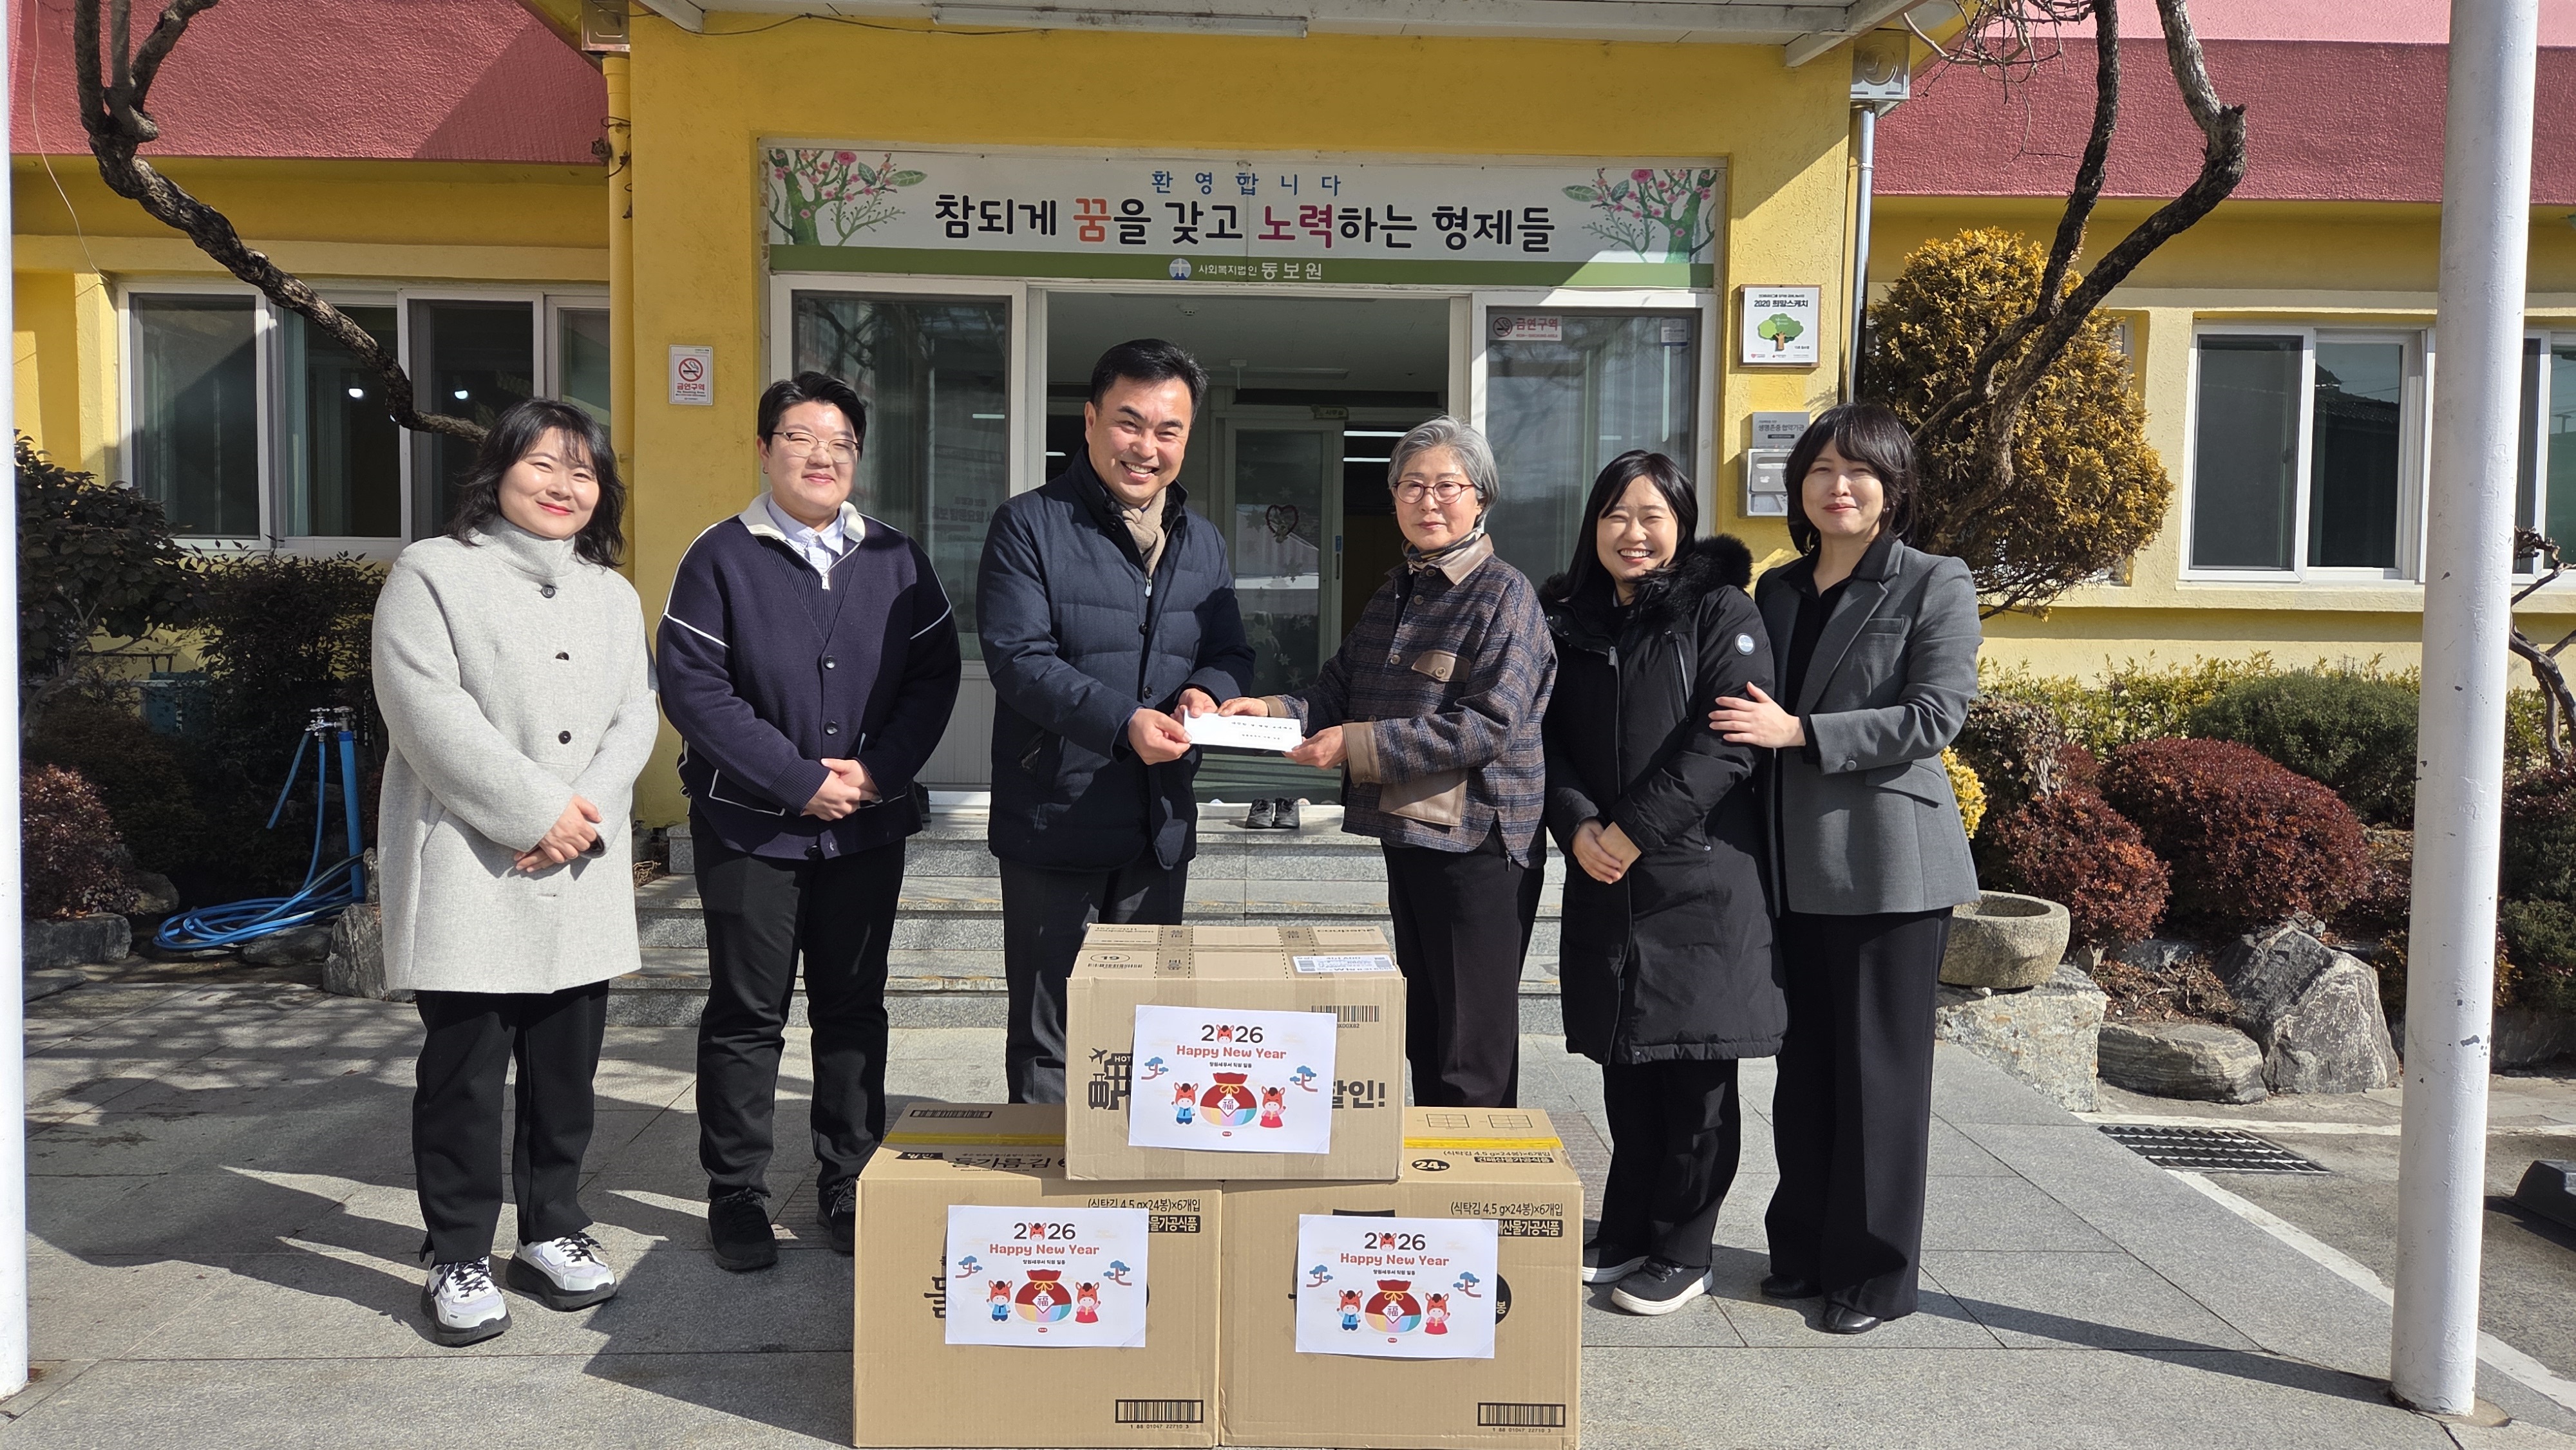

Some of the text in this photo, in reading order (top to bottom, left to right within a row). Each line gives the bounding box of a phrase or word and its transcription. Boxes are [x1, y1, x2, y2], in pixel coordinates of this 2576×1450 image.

[1151, 171, 1341, 196] 환영합니다
[934, 194, 1555, 253] 참되게 꿈을 갖고 노력하는 형제들
[1198, 261, 1321, 280] 사회복지법인 동보원
[1515, 317, 1558, 331] 금연구역
[677, 382, 705, 391] 금연구역
[1176, 1045, 1287, 1059] Happy New Year
[1451, 1201, 1481, 1215] (식탁김
[1483, 1203, 1497, 1214] 4.5
[1148, 1216, 1197, 1232] 물가공식품
[989, 1244, 1100, 1256] Happy New Year
[1340, 1253, 1450, 1266] Happy New Year
